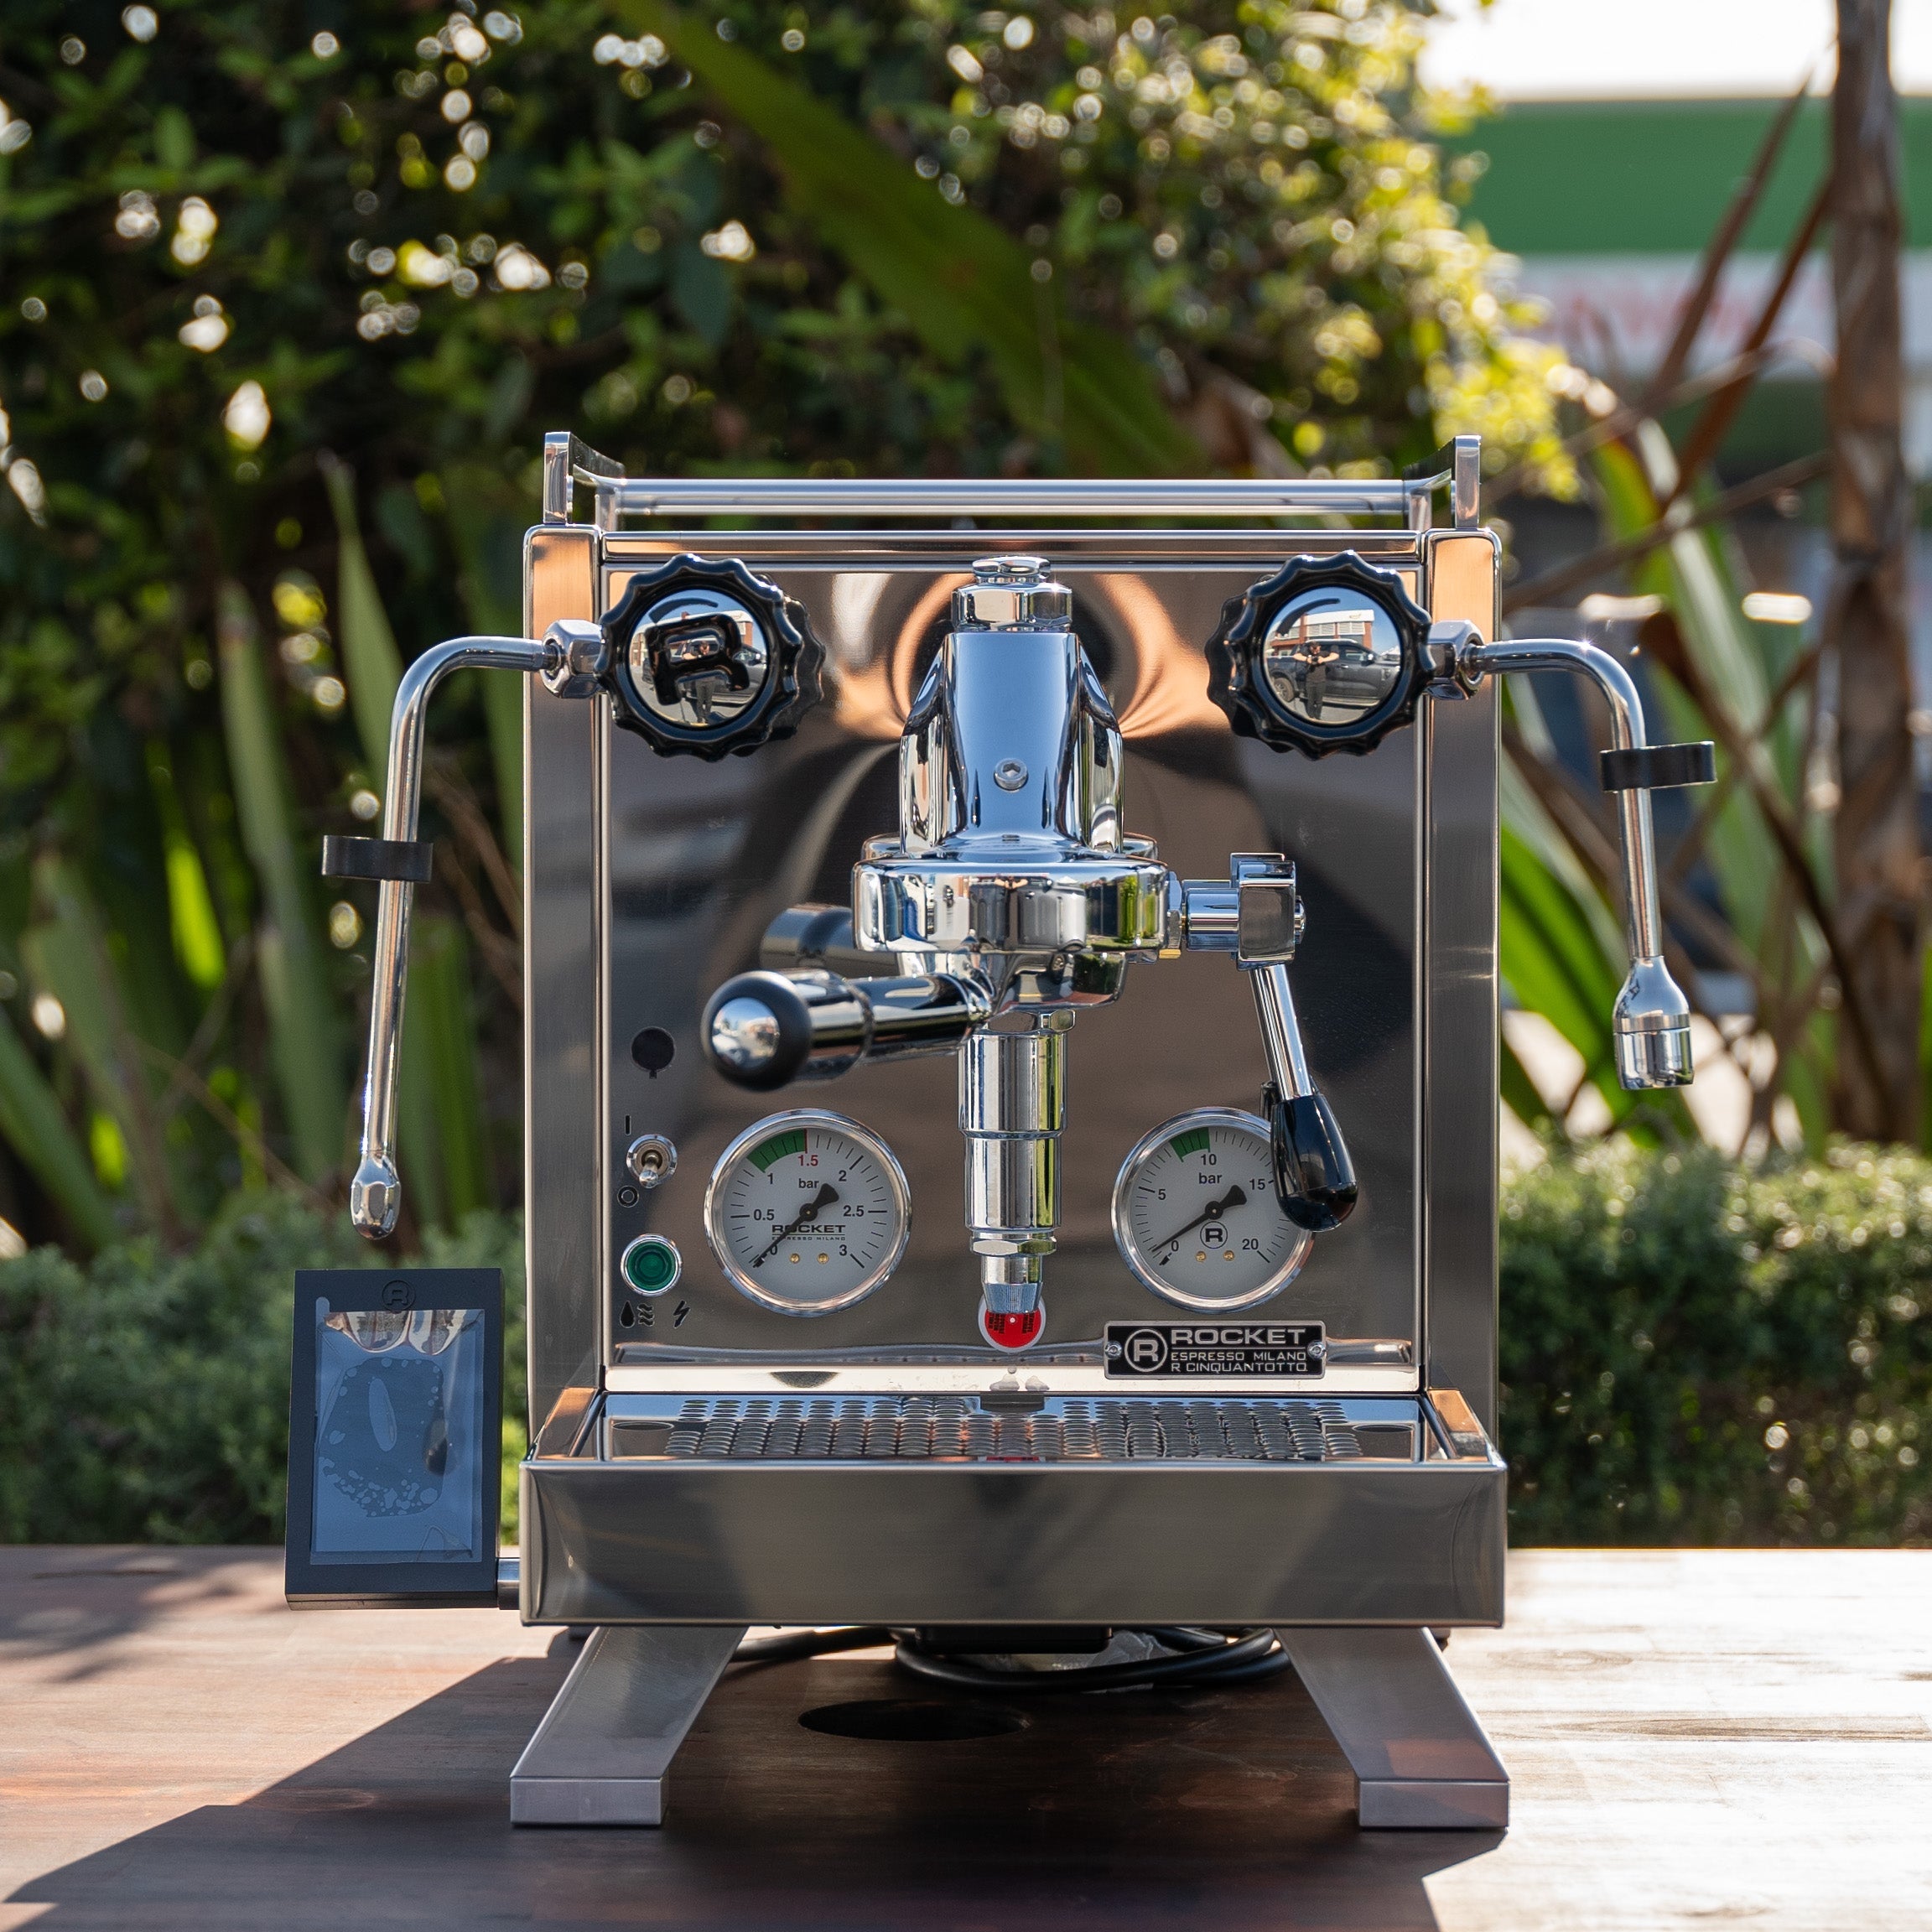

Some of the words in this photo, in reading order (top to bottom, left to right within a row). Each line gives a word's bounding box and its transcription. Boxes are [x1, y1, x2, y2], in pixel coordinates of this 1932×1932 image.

[797, 1154, 819, 1167] 1.5
[1200, 1154, 1217, 1166] 10
[767, 1172, 774, 1185] 1
[839, 1170, 848, 1182] 2
[1198, 1172, 1223, 1184] bar
[798, 1178, 819, 1189] bar
[1249, 1178, 1266, 1191] 15
[1158, 1188, 1166, 1201] 5
[753, 1209, 775, 1221] 0.5
[843, 1205, 865, 1218] 2.5
[839, 1244, 848, 1256] 3
[1171, 1240, 1179, 1252] 0
[1242, 1239, 1259, 1250] 20
[1171, 1328, 1306, 1345] ROCKET
[1171, 1352, 1244, 1361] ESPRESSO
[1254, 1352, 1306, 1361] MILANO
[1171, 1363, 1182, 1372] R
[1186, 1363, 1308, 1374] CINQUANTOTTO
